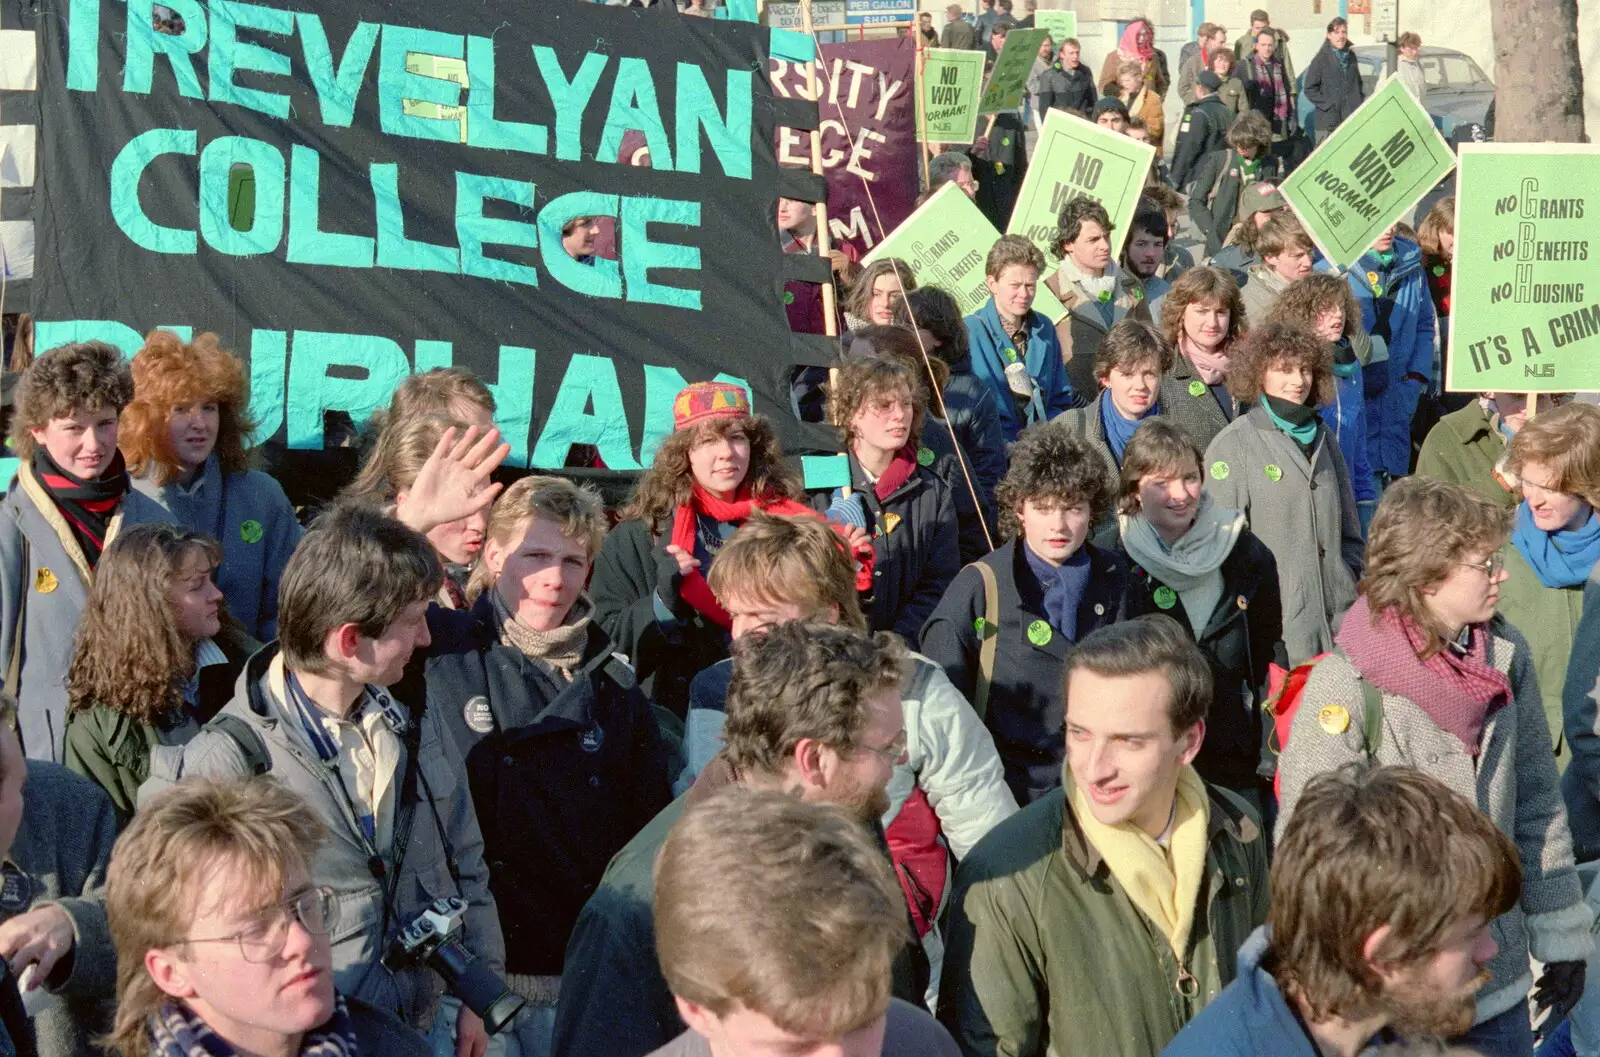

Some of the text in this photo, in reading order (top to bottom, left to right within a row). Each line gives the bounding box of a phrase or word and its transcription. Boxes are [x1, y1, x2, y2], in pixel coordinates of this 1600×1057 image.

[850, 0, 911, 9] PER GALLON
[864, 15, 897, 24] SHOP
[940, 66, 959, 86] NO
[925, 105, 967, 122] ORMAN!
[931, 86, 962, 105] WAY
[1381, 128, 1415, 169] NO
[1069, 152, 1104, 190] NO
[1349, 143, 1396, 200] WAY
[1314, 170, 1381, 222] NORMAN!
[1495, 177, 1585, 219] NO GRANTS
[110, 128, 703, 311] COLLEGE
[1493, 221, 1589, 261] NO BENEFITS
[1491, 263, 1584, 304] NO HOUSING
[1469, 335, 1512, 373] IT'S
[1522, 327, 1541, 358] A
[1524, 363, 1555, 378] NUS
[1029, 622, 1042, 634] NO
[476, 704, 489, 712] NO
